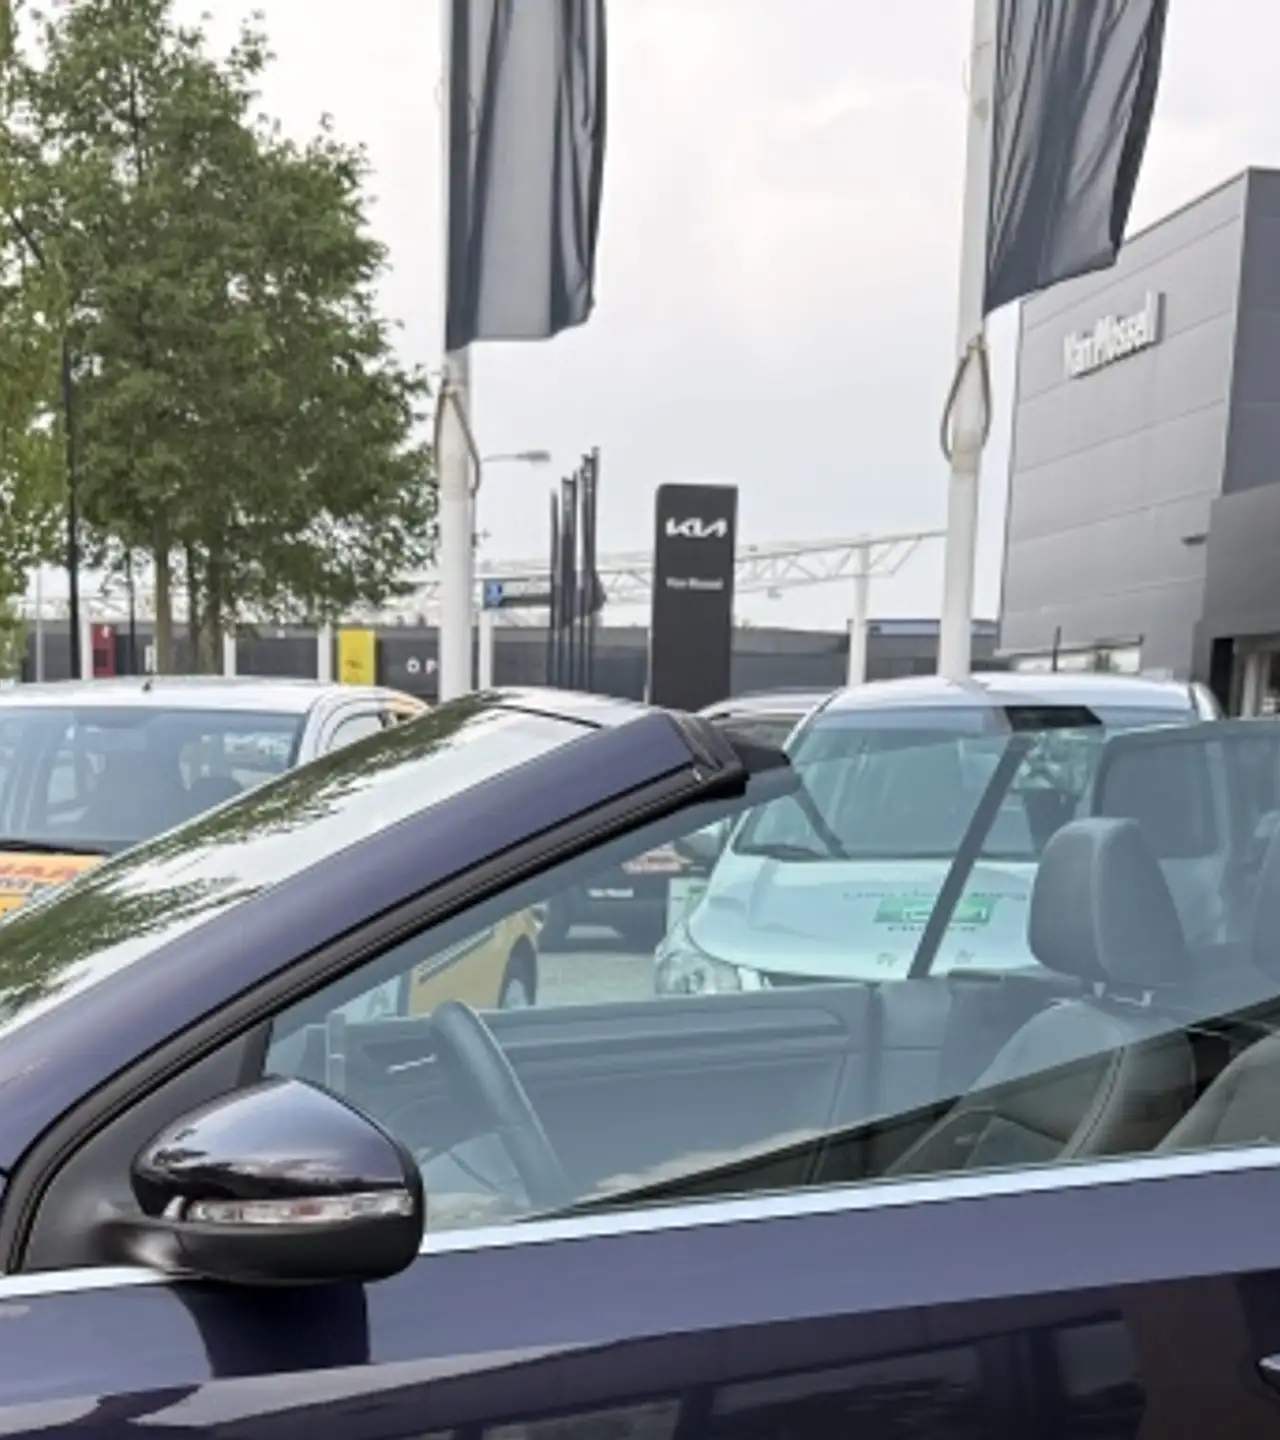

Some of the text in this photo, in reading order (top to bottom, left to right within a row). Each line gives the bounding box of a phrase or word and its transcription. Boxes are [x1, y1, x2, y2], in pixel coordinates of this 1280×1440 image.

[1063, 289, 1156, 379] Van Mossel
[665, 517, 728, 538] KIA
